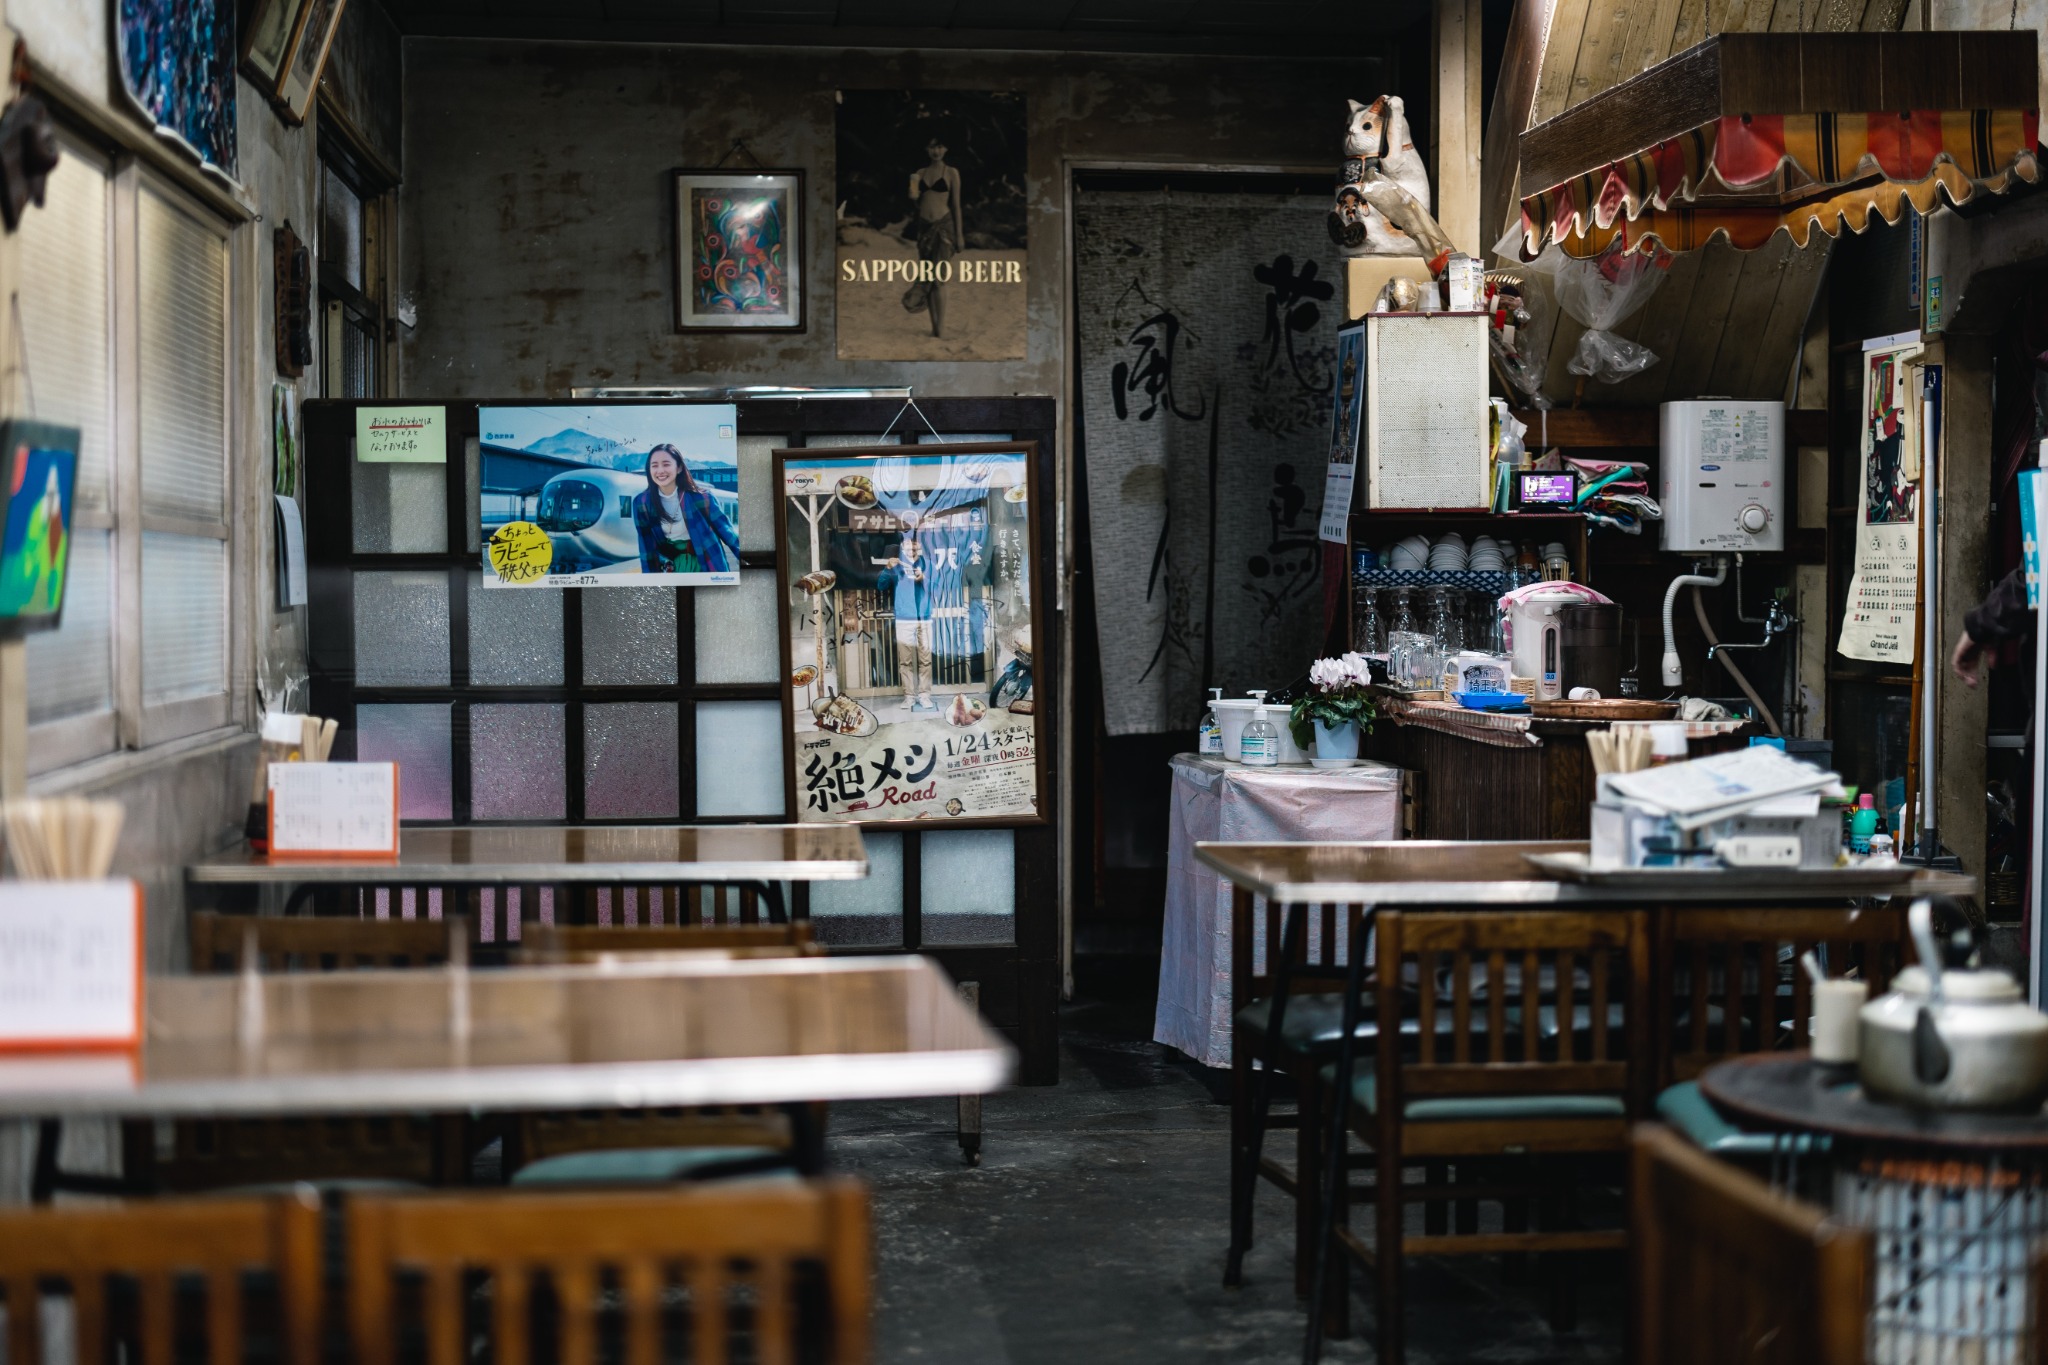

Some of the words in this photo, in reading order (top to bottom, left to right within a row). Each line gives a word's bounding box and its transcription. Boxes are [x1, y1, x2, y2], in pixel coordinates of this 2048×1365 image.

[842, 259, 953, 283] SAPPORO
[959, 260, 1022, 283] BEER
[503, 523, 537, 539] ちょっと
[853, 514, 896, 530] アサヒ
[494, 541, 550, 565] ラビューで
[998, 529, 1010, 582] 行きますか。
[1011, 529, 1023, 598] さて、いただきに
[498, 561, 549, 584] 秩父まで
[1870, 639, 1889, 650] Grand
[944, 731, 991, 757] 1/24
[991, 731, 1035, 748] スタート
[804, 743, 938, 814] 絶メシ
[881, 780, 939, 807] Road
